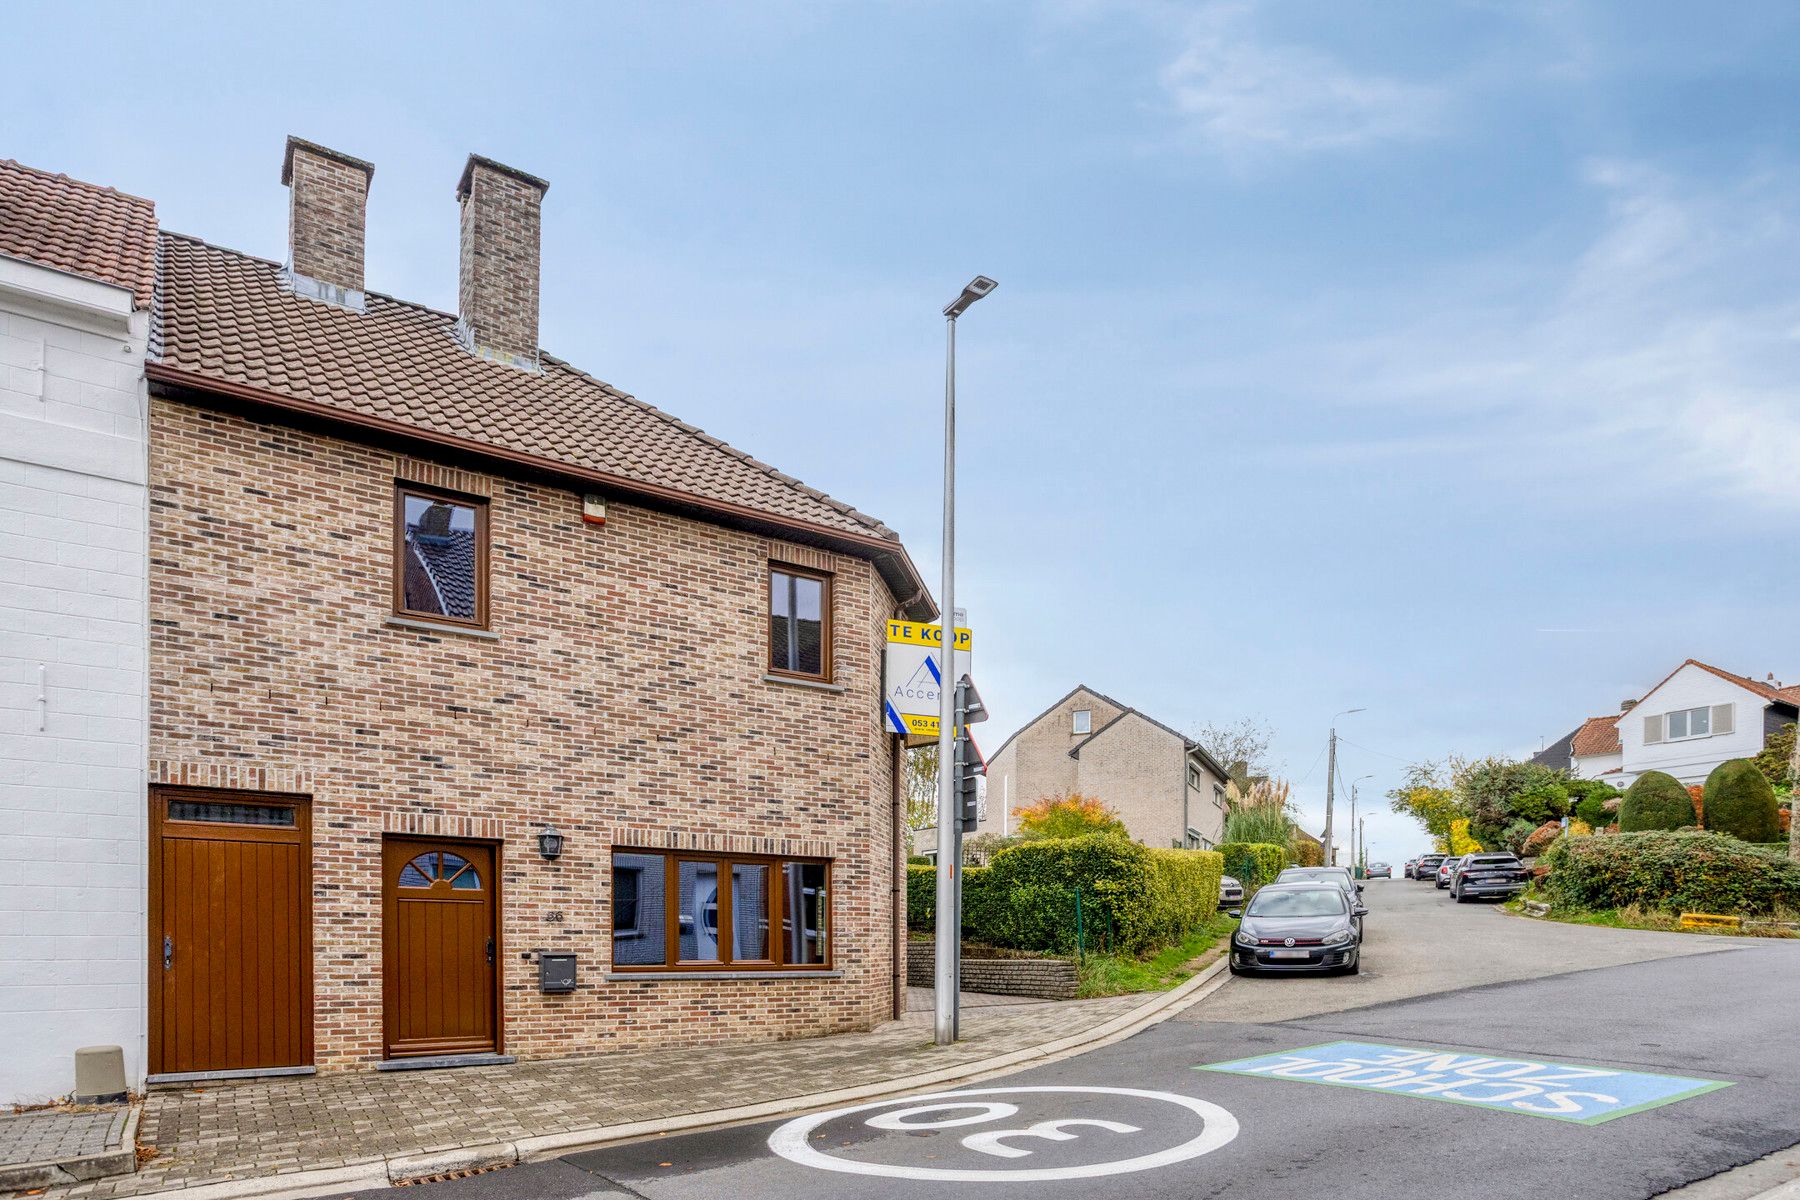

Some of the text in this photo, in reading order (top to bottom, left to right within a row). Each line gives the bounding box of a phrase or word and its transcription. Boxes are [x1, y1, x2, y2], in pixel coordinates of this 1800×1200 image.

[890, 624, 970, 644] TE KOP
[911, 719, 928, 728] 053
[1240, 1056, 1619, 1113] SCHOOL
[1343, 1048, 1621, 1087] ZONE
[865, 1101, 1142, 1158] 30
